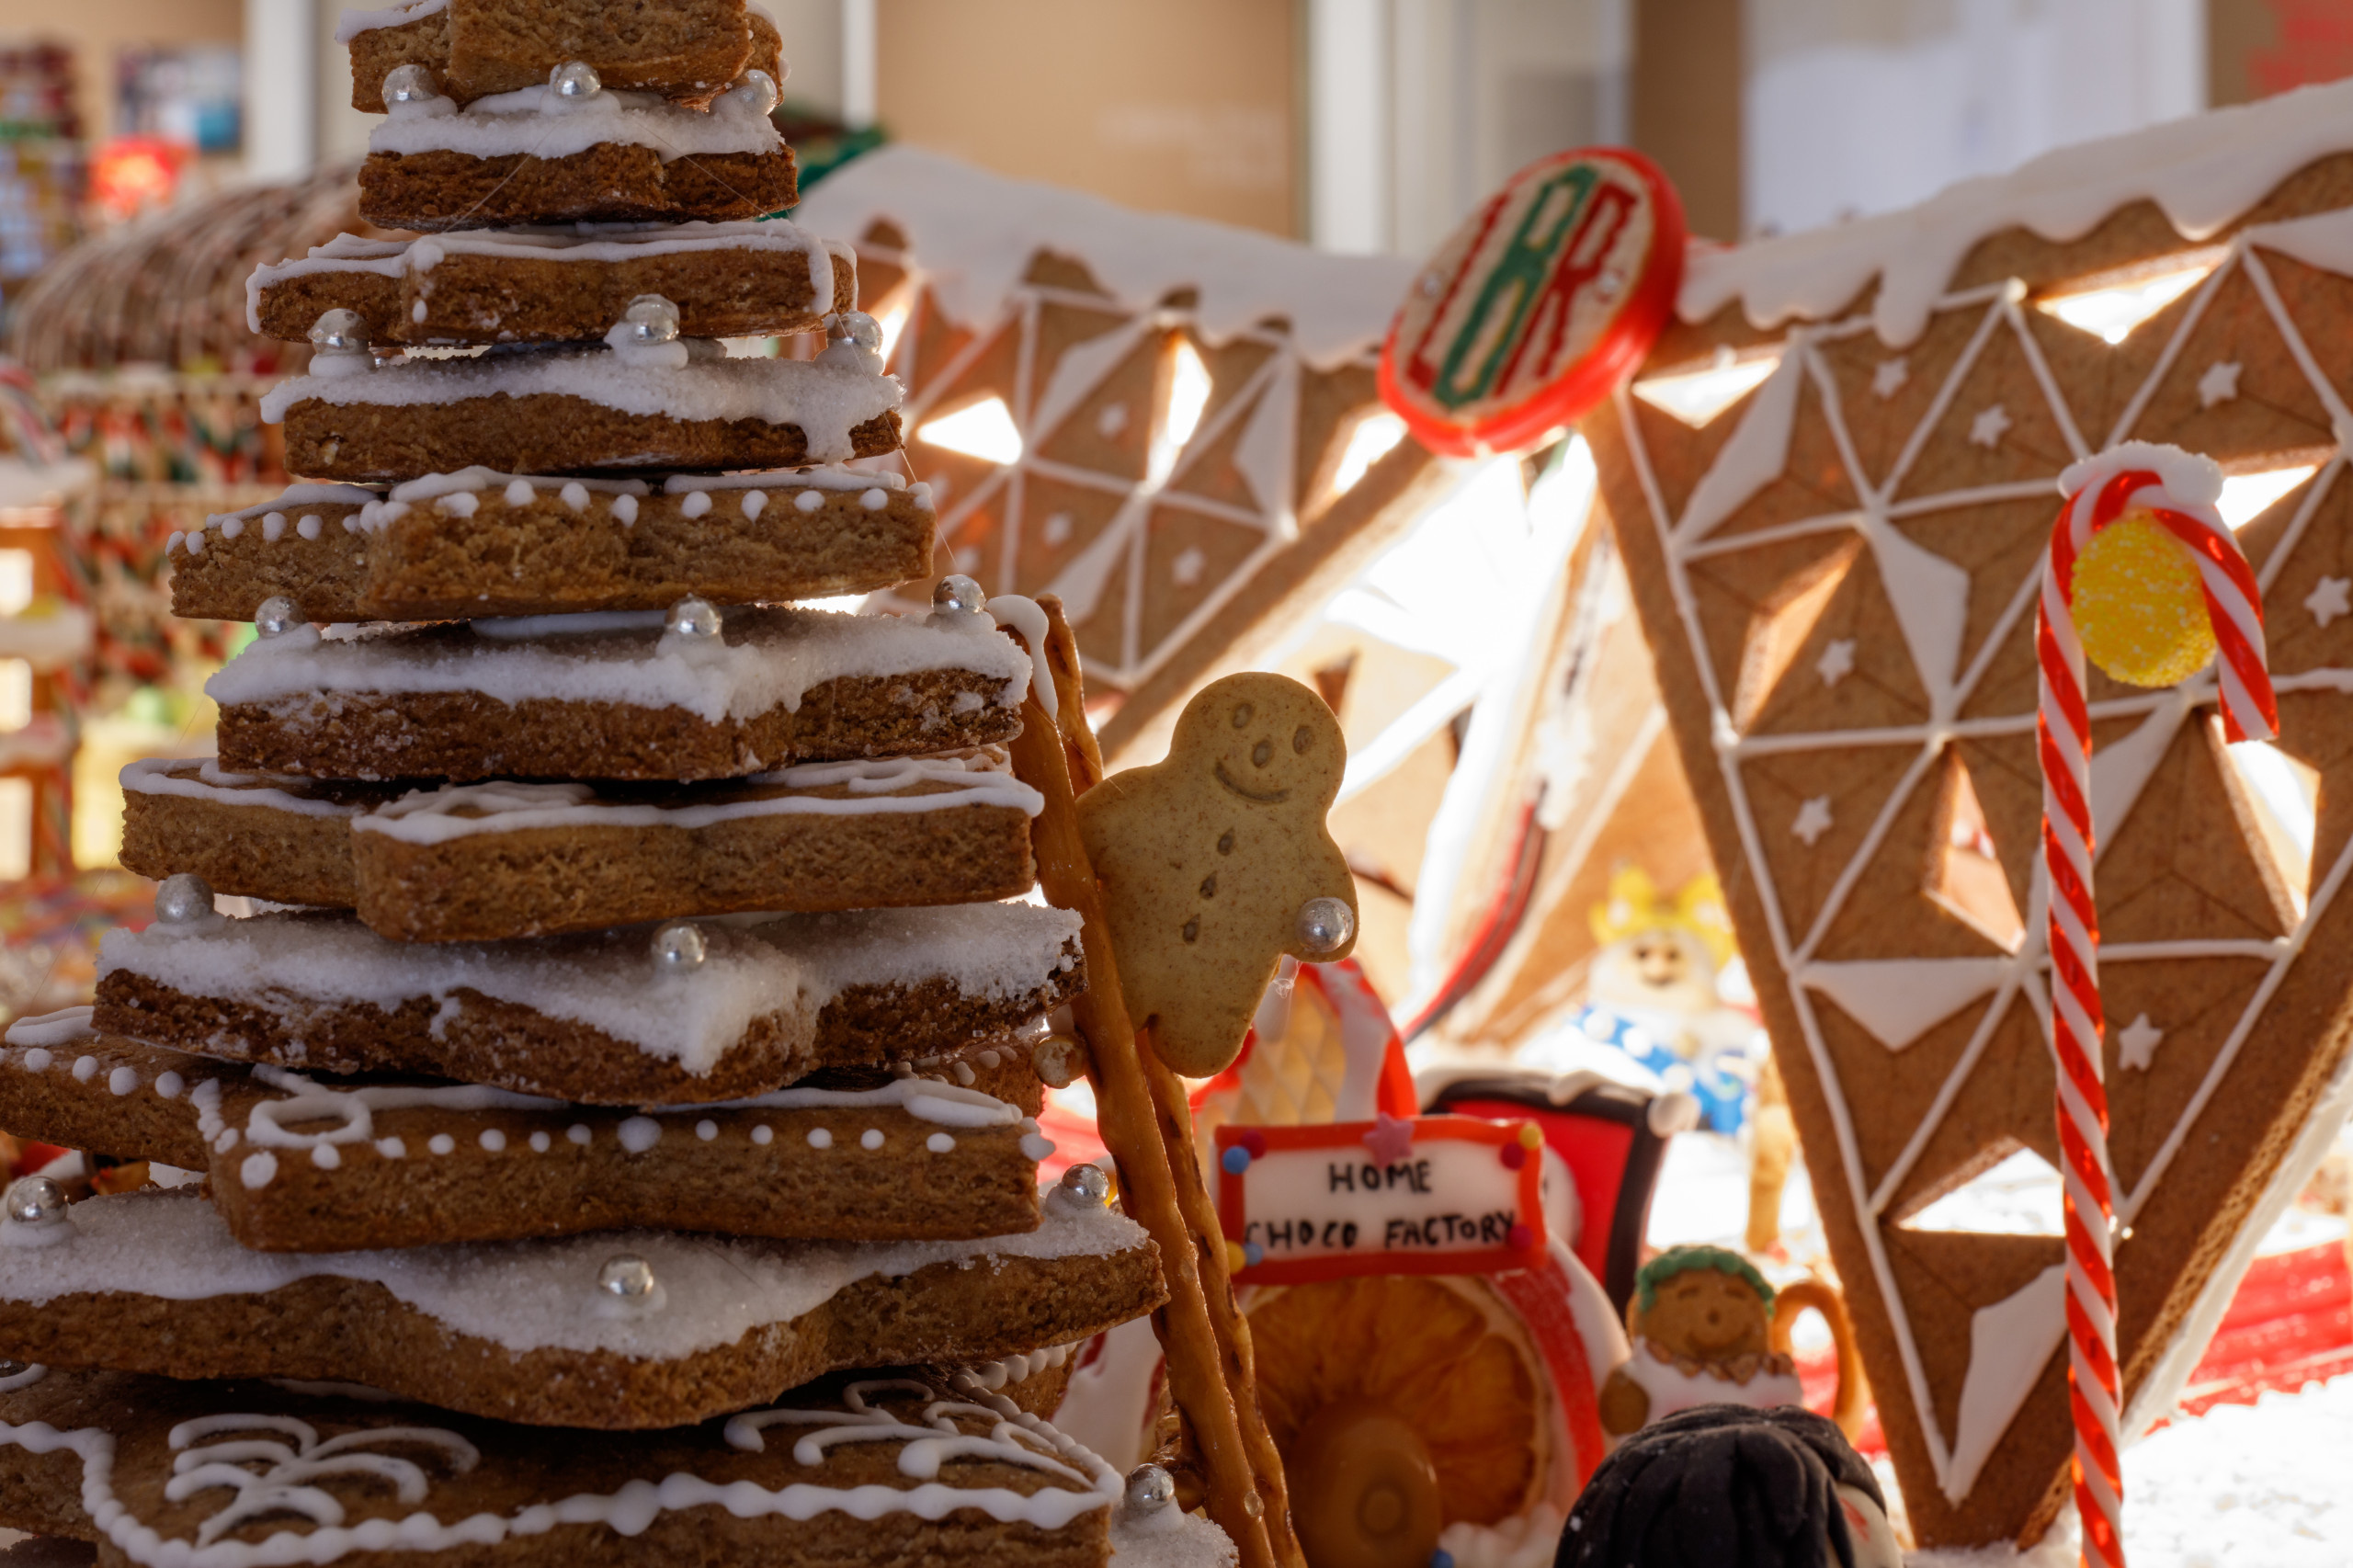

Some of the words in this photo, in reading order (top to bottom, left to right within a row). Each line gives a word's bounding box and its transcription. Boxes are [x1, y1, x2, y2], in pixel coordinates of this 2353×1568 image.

[1328, 1159, 1433, 1195] HOME
[1245, 1220, 1359, 1250] CHOCO
[1384, 1210, 1516, 1250] FACTORY
